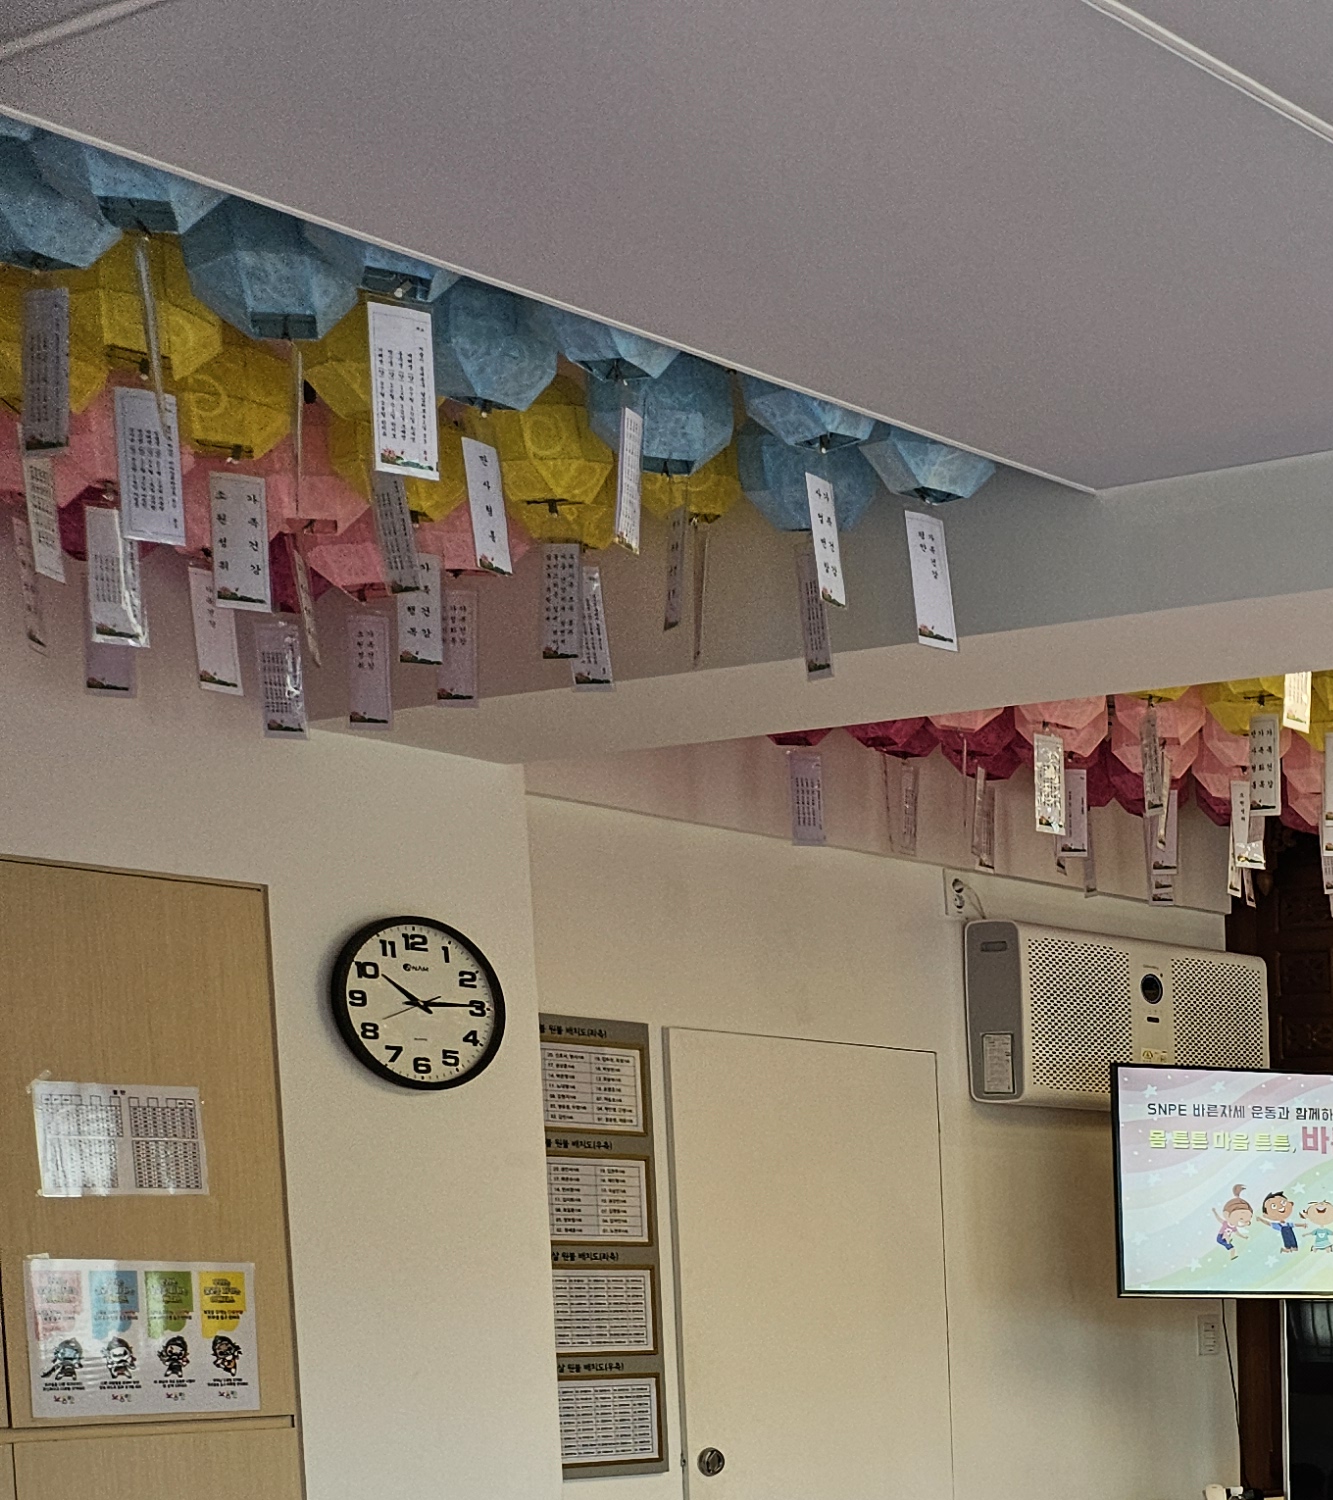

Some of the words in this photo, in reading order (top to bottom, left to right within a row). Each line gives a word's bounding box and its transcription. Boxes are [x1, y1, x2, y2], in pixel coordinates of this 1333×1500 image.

[379, 940, 397, 958] 11
[402, 933, 429, 952] 12
[442, 946, 450, 963] 1
[355, 961, 379, 979] 10
[459, 971, 477, 988] 2
[349, 990, 367, 1007] 9
[469, 1000, 486, 1017] 3
[361, 1022, 379, 1040] 8
[463, 1030, 479, 1046] 4
[385, 1045, 403, 1063] 7
[442, 1049, 459, 1066] 5
[413, 1057, 432, 1074] 6
[1147, 1103, 1187, 1116] SNPE
[1193, 1104, 1245, 1118] 바른자세
[1251, 1105, 1290, 1120] 운동과
[1149, 1130, 1167, 1149] 몸
[1172, 1131, 1208, 1149] 튼튼
[1213, 1131, 1249, 1151] 마음
